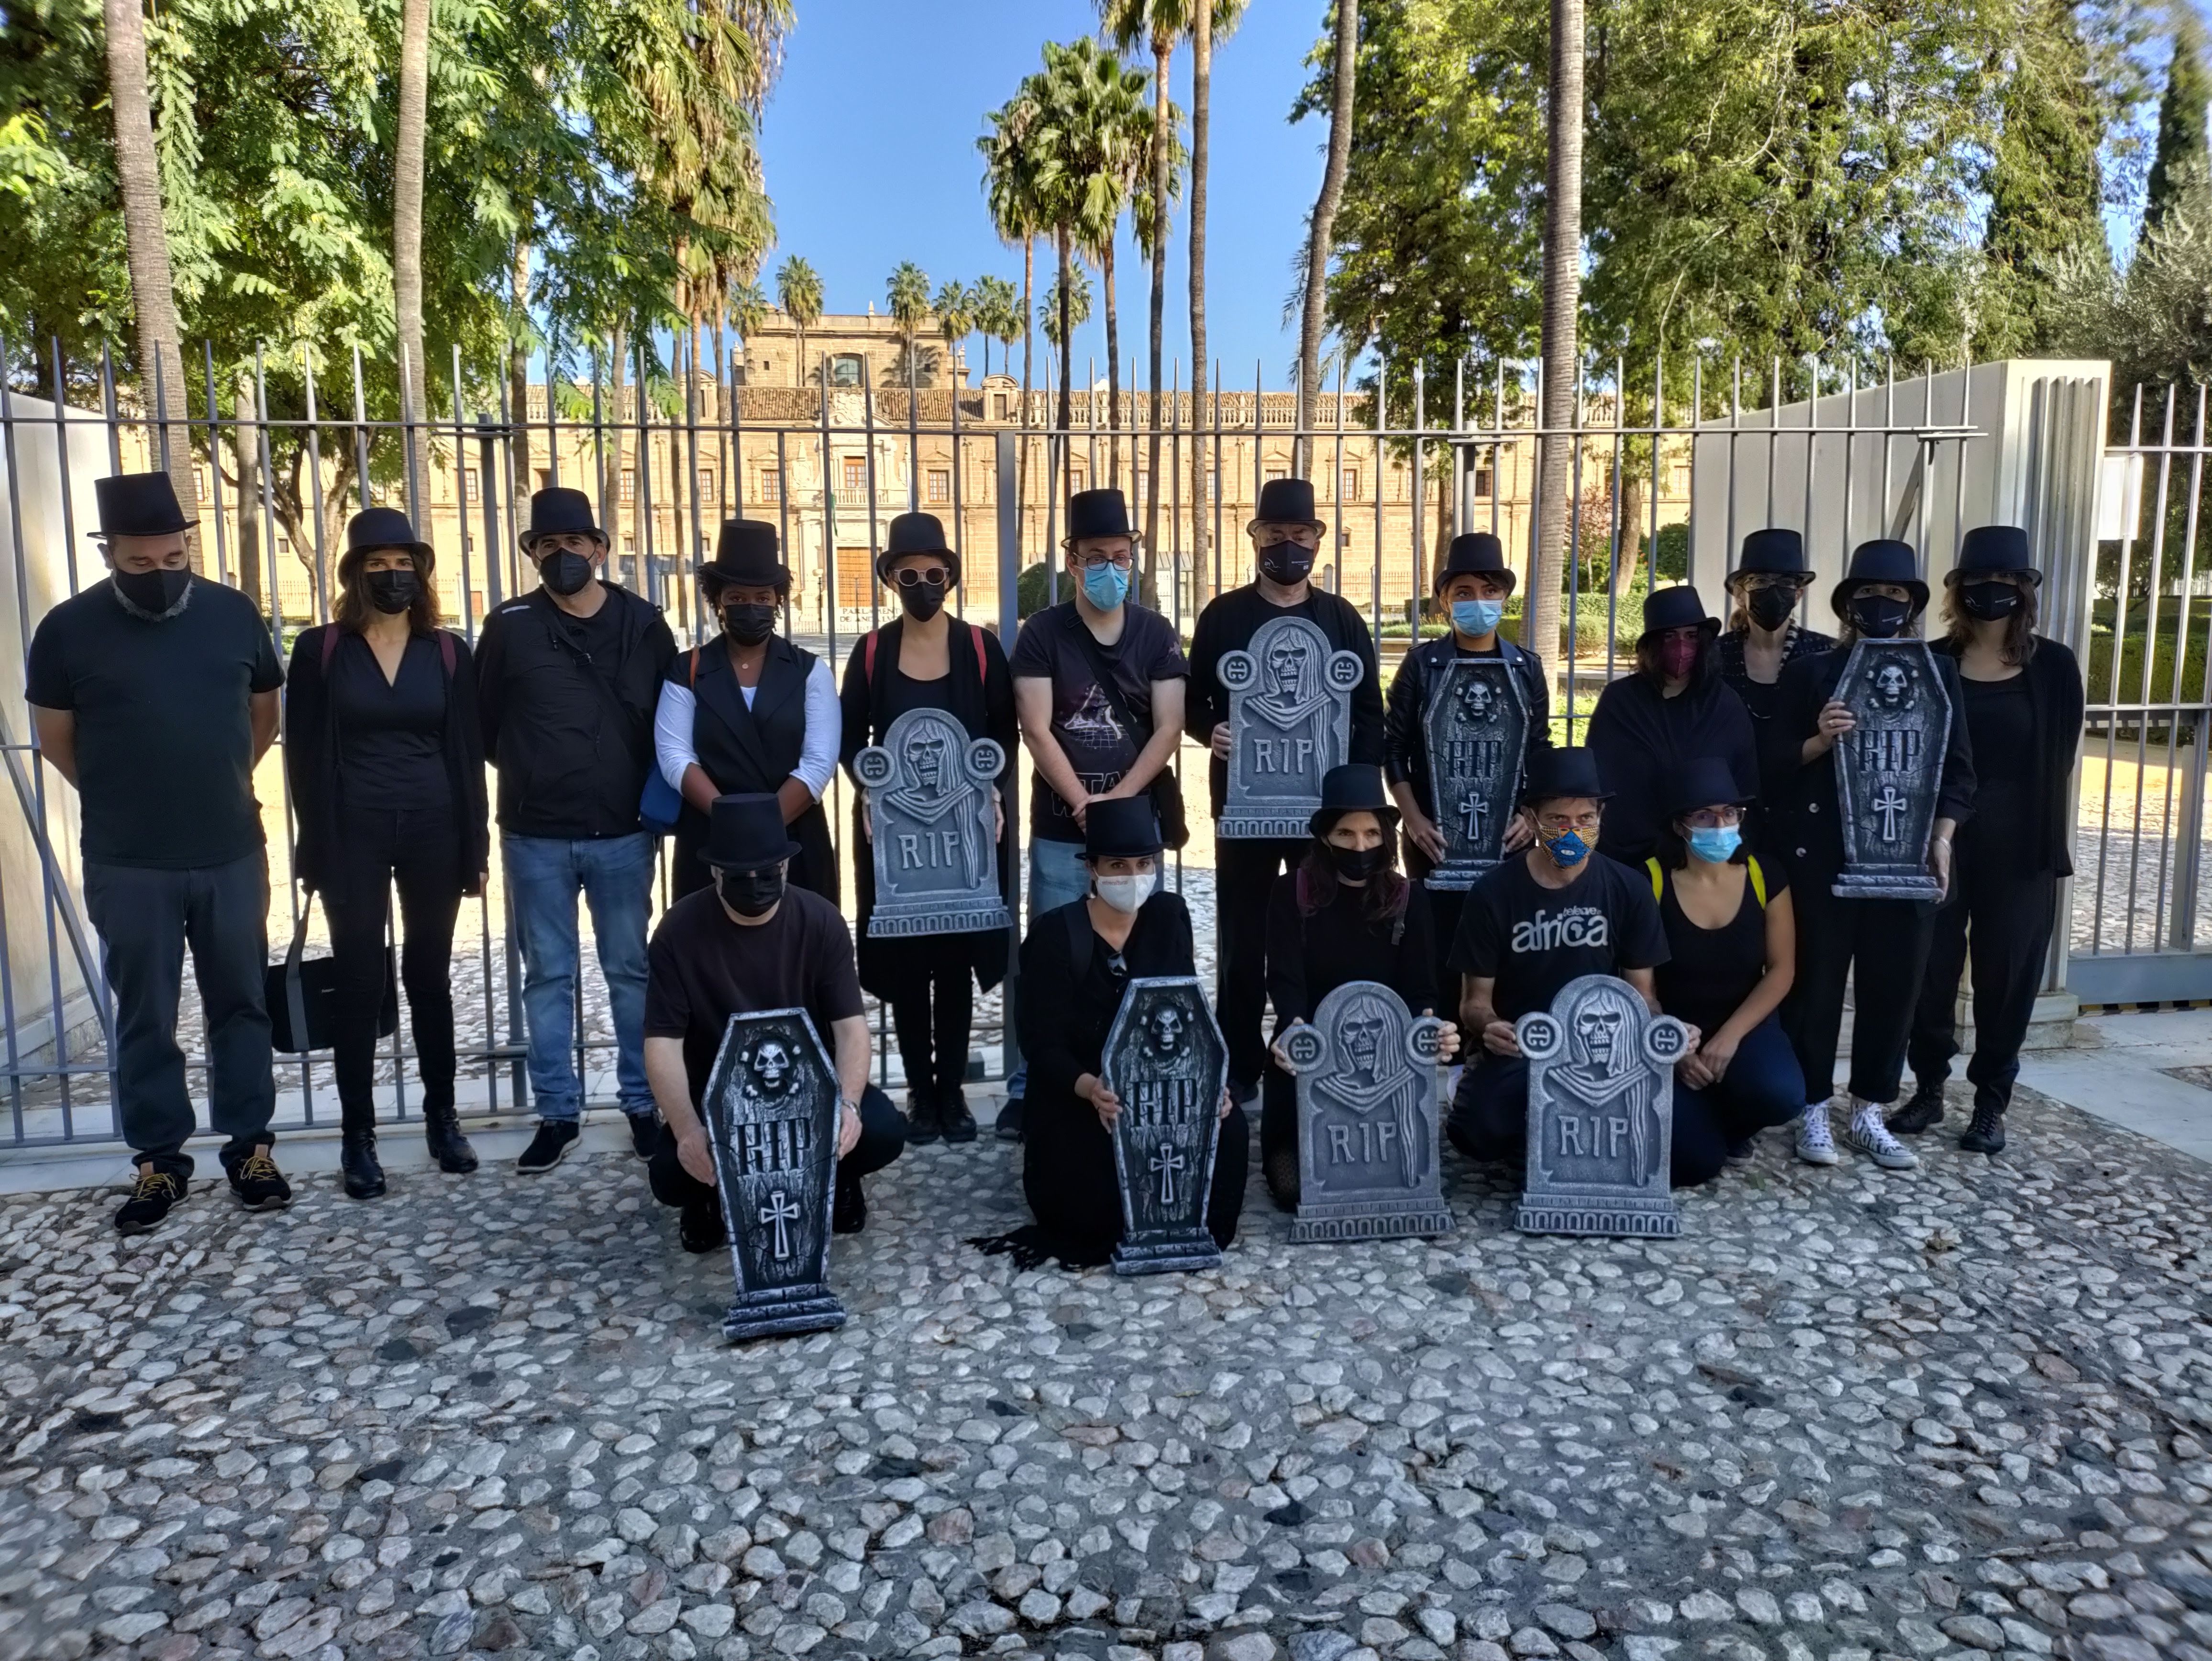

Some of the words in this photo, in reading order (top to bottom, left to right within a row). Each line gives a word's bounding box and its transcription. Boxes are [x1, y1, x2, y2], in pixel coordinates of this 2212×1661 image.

[1253, 739, 1313, 774] RIP
[1446, 741, 1502, 779] RIP
[1856, 730, 1920, 771] RIP
[898, 831, 960, 869] RIP
[1512, 909, 1608, 953] africa
[1129, 1079, 1197, 1128] RIP
[734, 1117, 811, 1176] RIP
[1327, 1122, 1397, 1164] RIP
[1558, 1115, 1628, 1158] RIP
